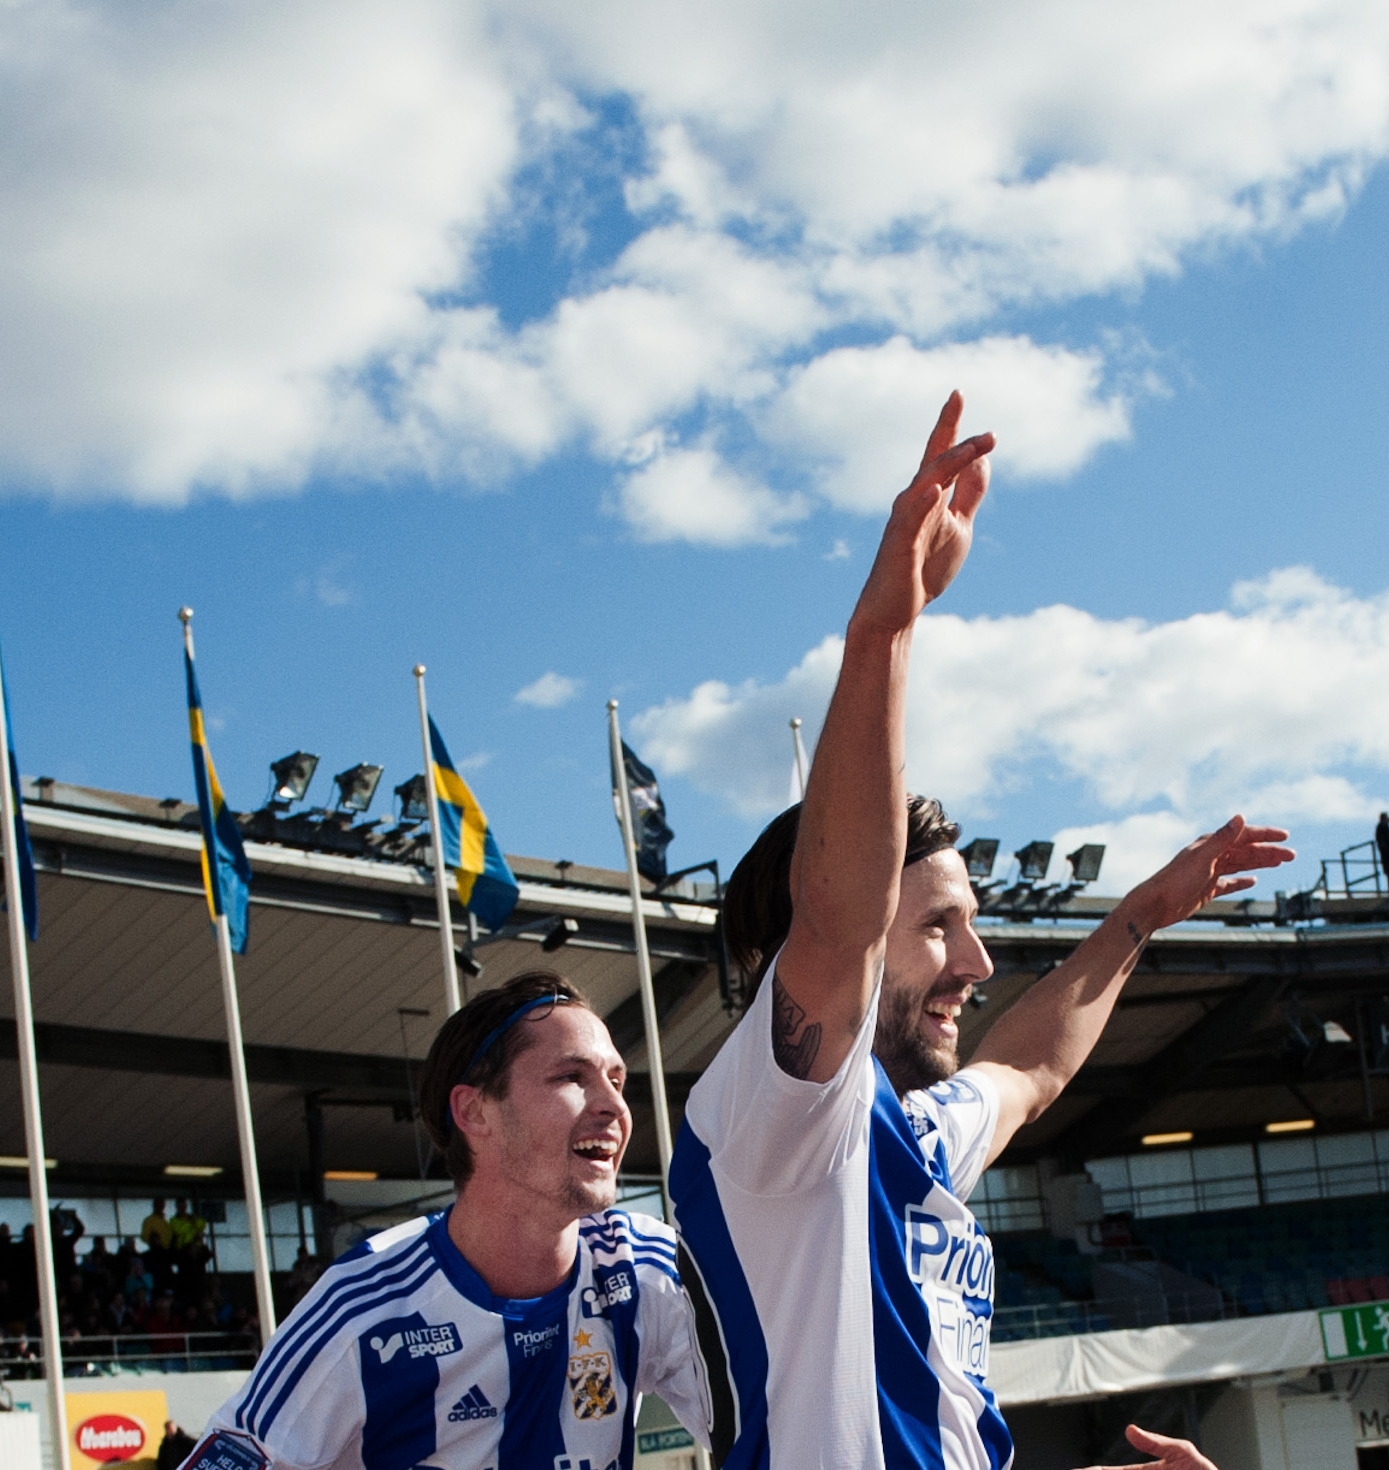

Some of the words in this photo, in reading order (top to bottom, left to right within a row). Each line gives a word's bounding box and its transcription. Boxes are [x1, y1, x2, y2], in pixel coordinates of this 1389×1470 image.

[405, 1326, 453, 1345] INTER
[408, 1339, 456, 1359] SPORT
[448, 1406, 498, 1422] adidas
